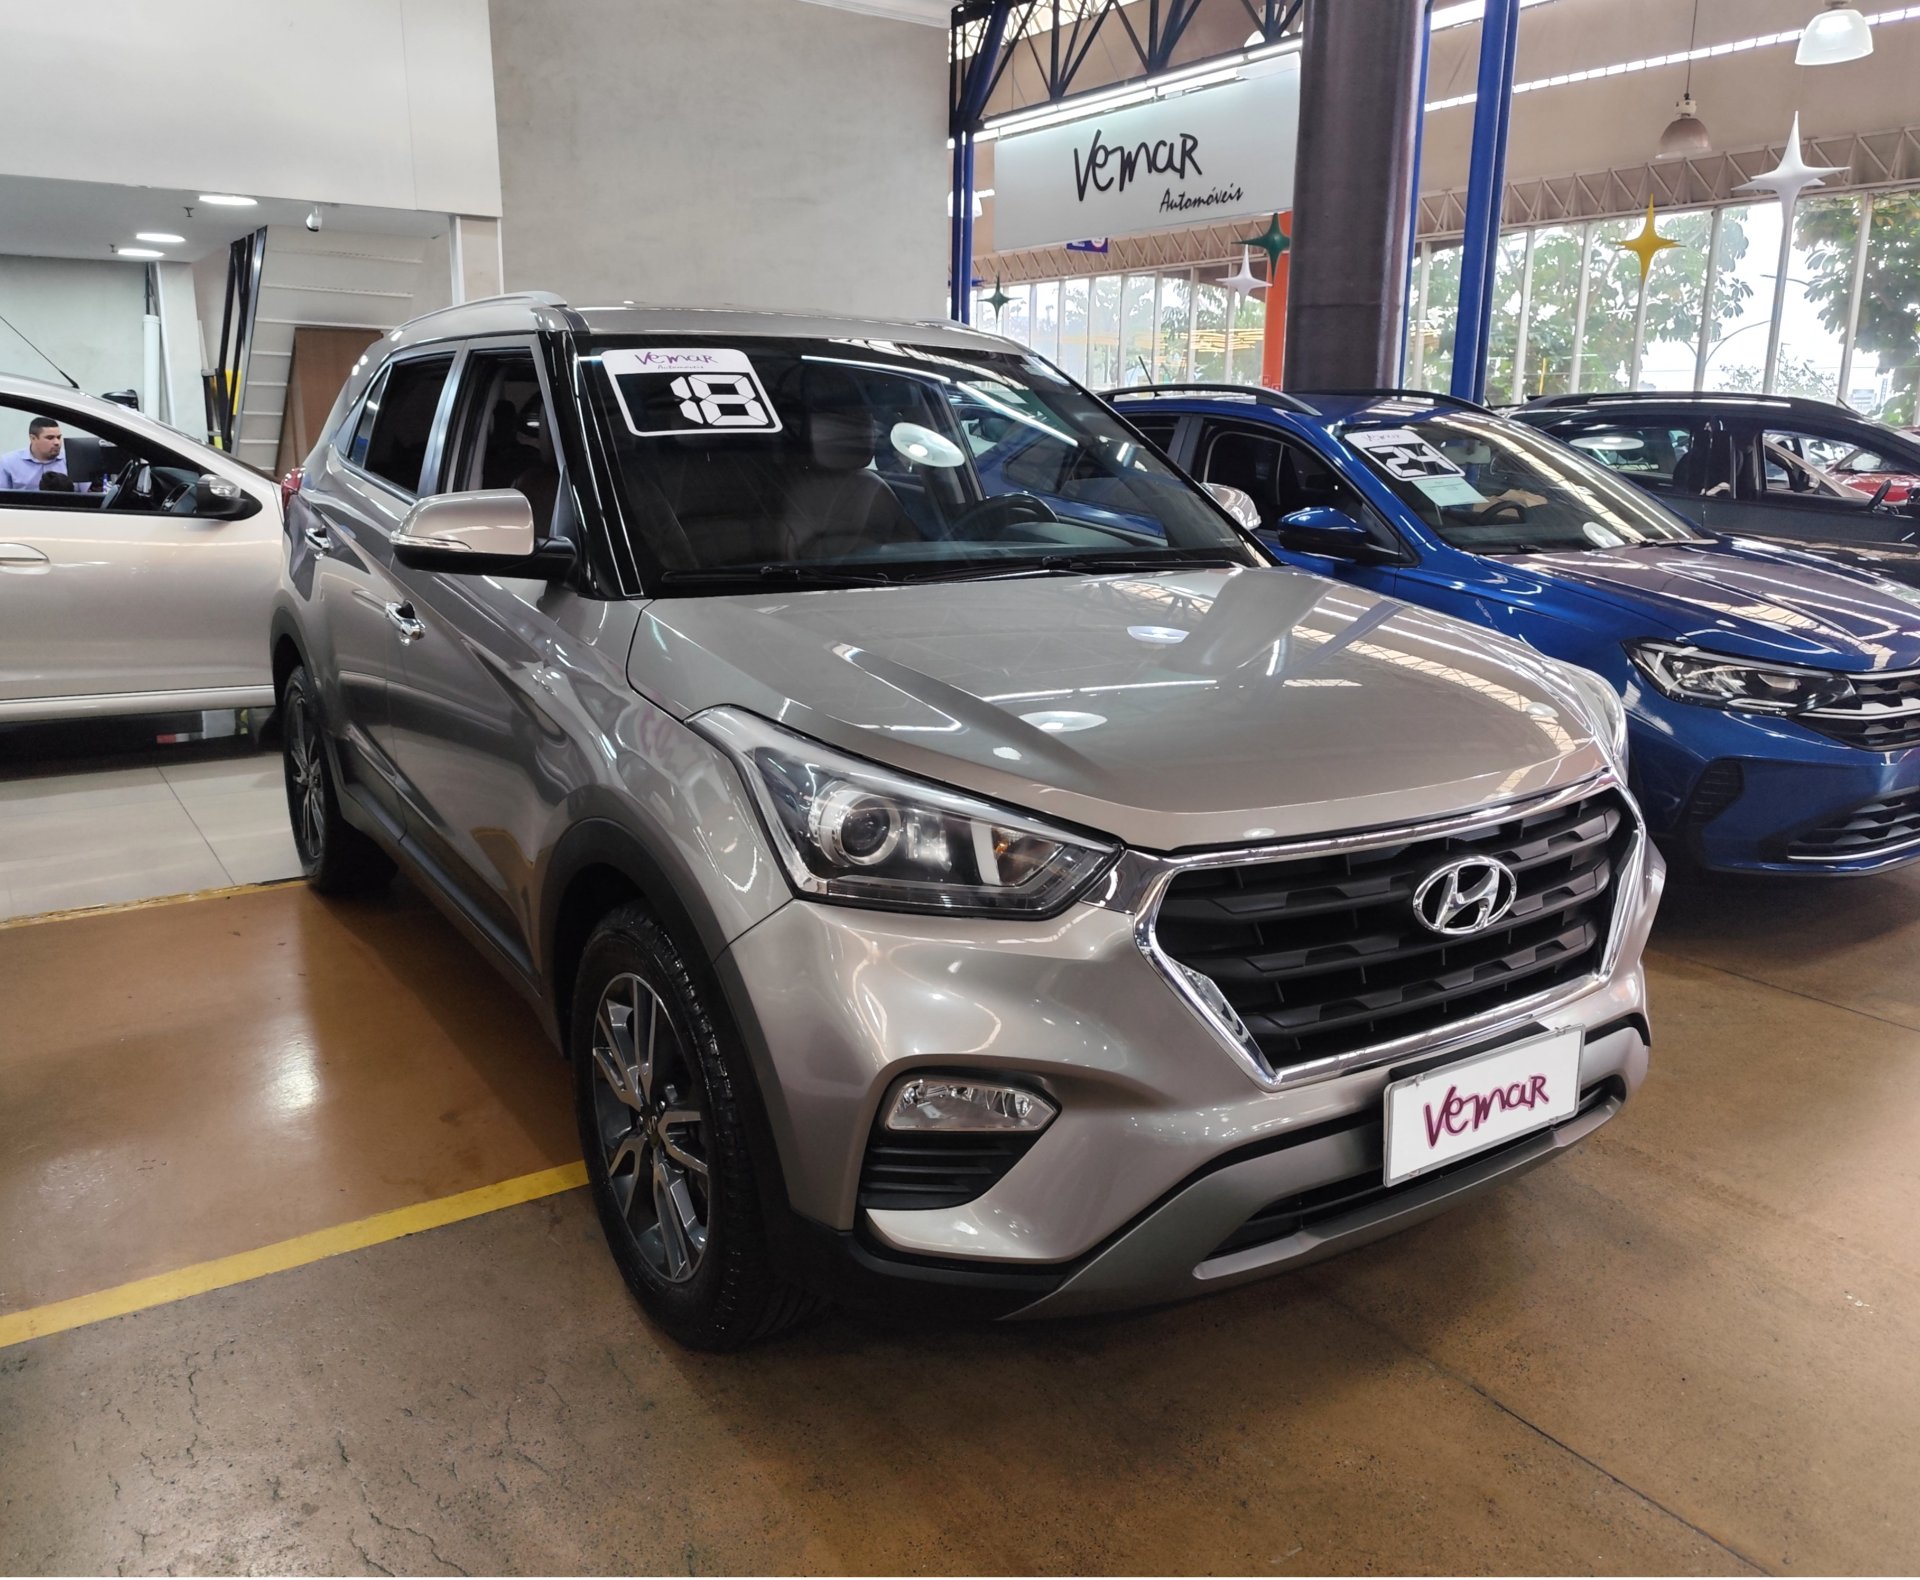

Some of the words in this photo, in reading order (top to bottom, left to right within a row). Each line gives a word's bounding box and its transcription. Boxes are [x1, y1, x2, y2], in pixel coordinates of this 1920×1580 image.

[1159, 183, 1244, 213] Automóveis
[670, 374, 769, 426] 18
[1369, 445, 1456, 477] 24
